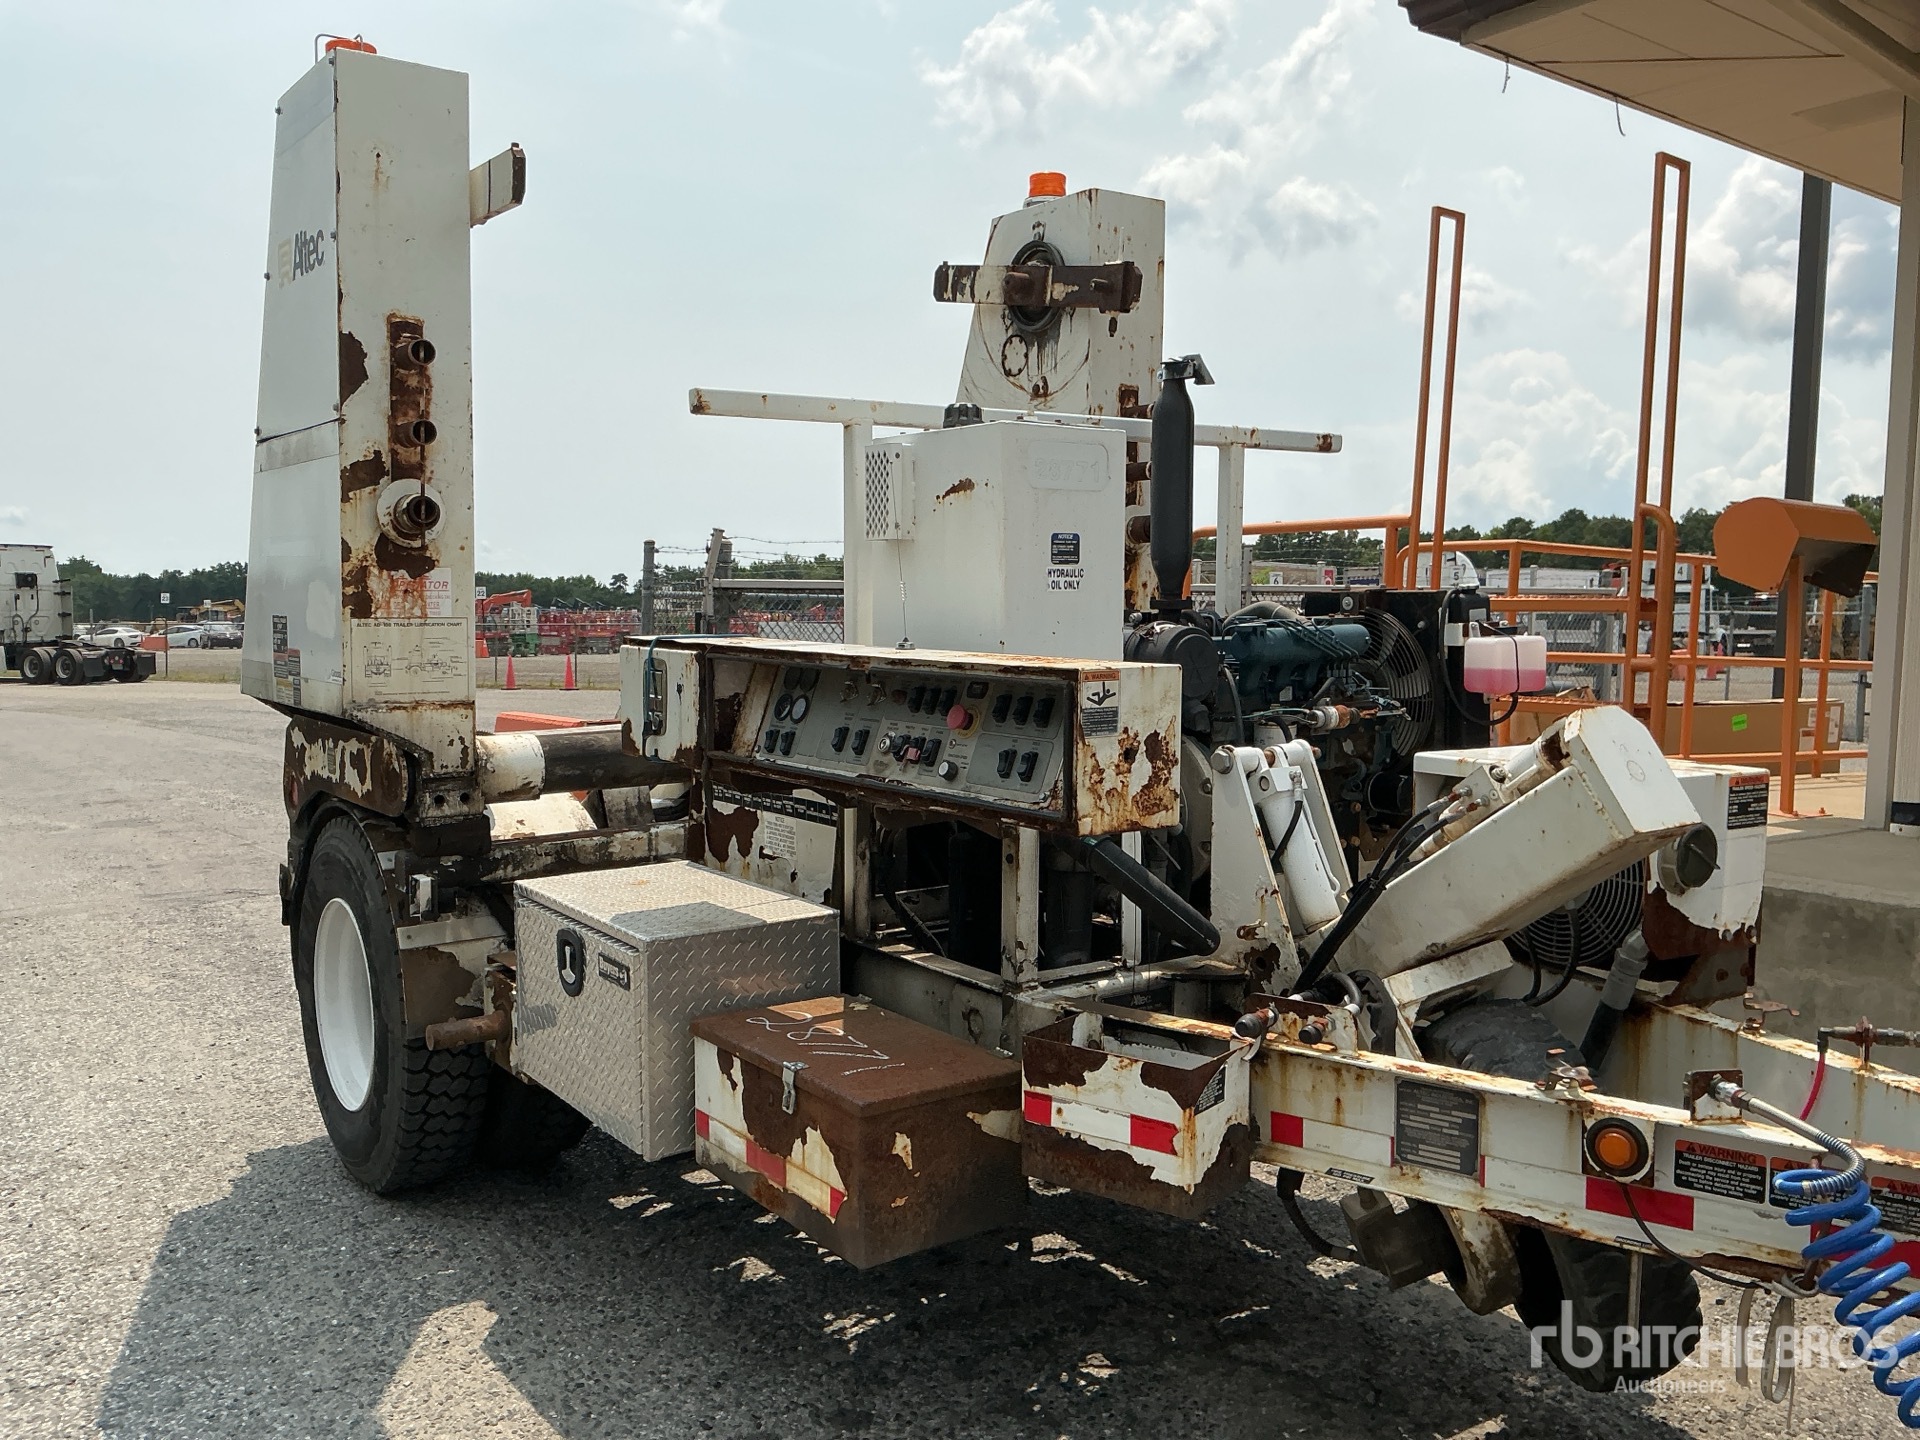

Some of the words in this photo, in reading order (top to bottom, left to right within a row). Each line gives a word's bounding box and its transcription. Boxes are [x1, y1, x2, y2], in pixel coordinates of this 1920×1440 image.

[292, 230, 325, 281] Altec
[1047, 568, 1084, 578] HYDRAULIC
[1454, 572, 1460, 580] 5
[1050, 580, 1062, 590] OIL
[1064, 580, 1080, 590] ONLY
[1274, 576, 1279, 585] 6
[1698, 1144, 1757, 1164] WARNING
[1683, 1153, 1702, 1161] TRAILER
[1704, 1157, 1737, 1167] DISCONNECT
